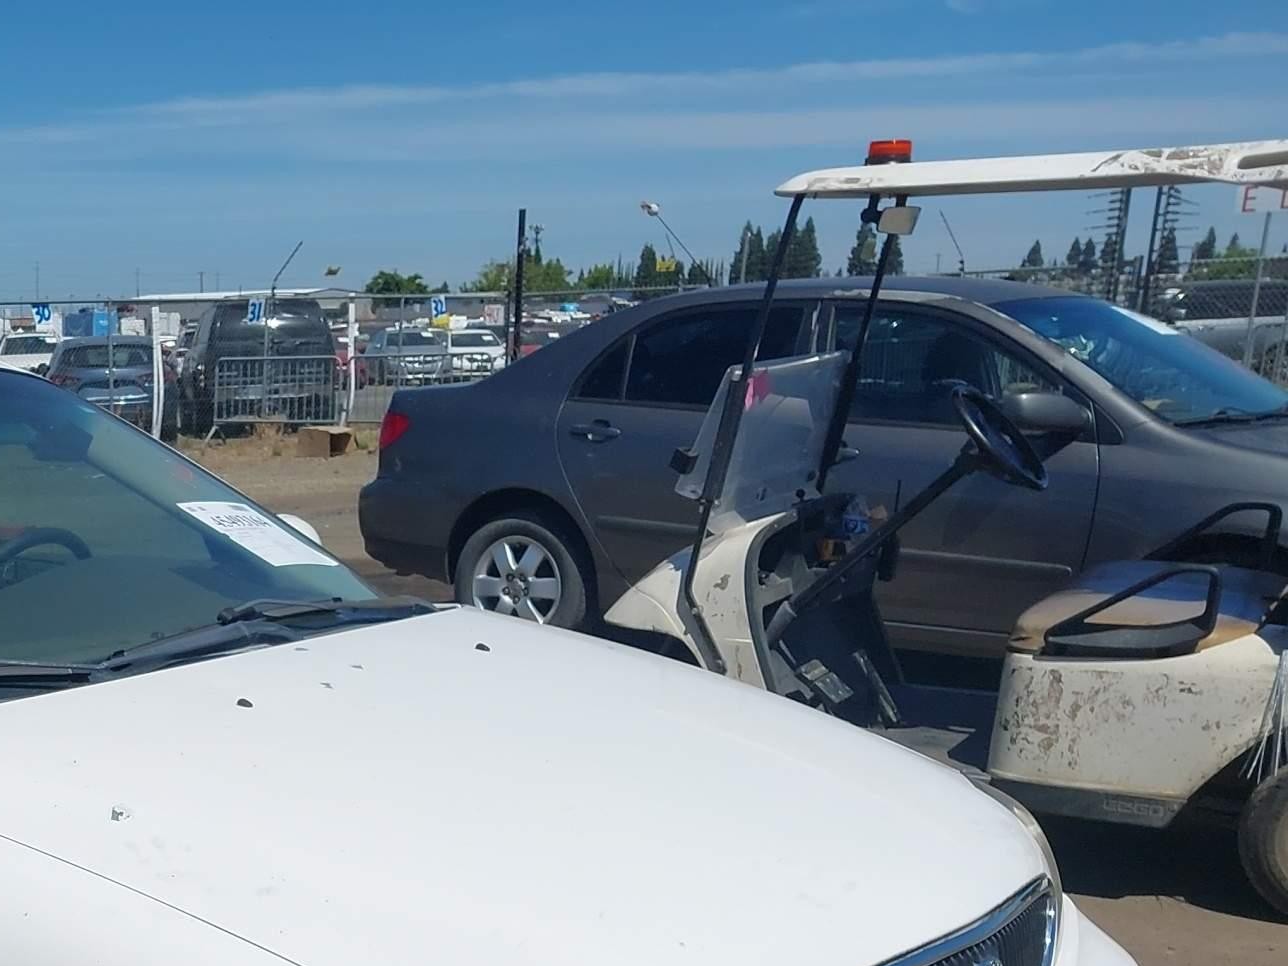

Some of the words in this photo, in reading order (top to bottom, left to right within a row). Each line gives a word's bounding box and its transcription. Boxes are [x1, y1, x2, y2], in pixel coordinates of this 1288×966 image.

[1242, 185, 1259, 212] E
[34, 304, 51, 324] 30
[249, 302, 262, 322] 31
